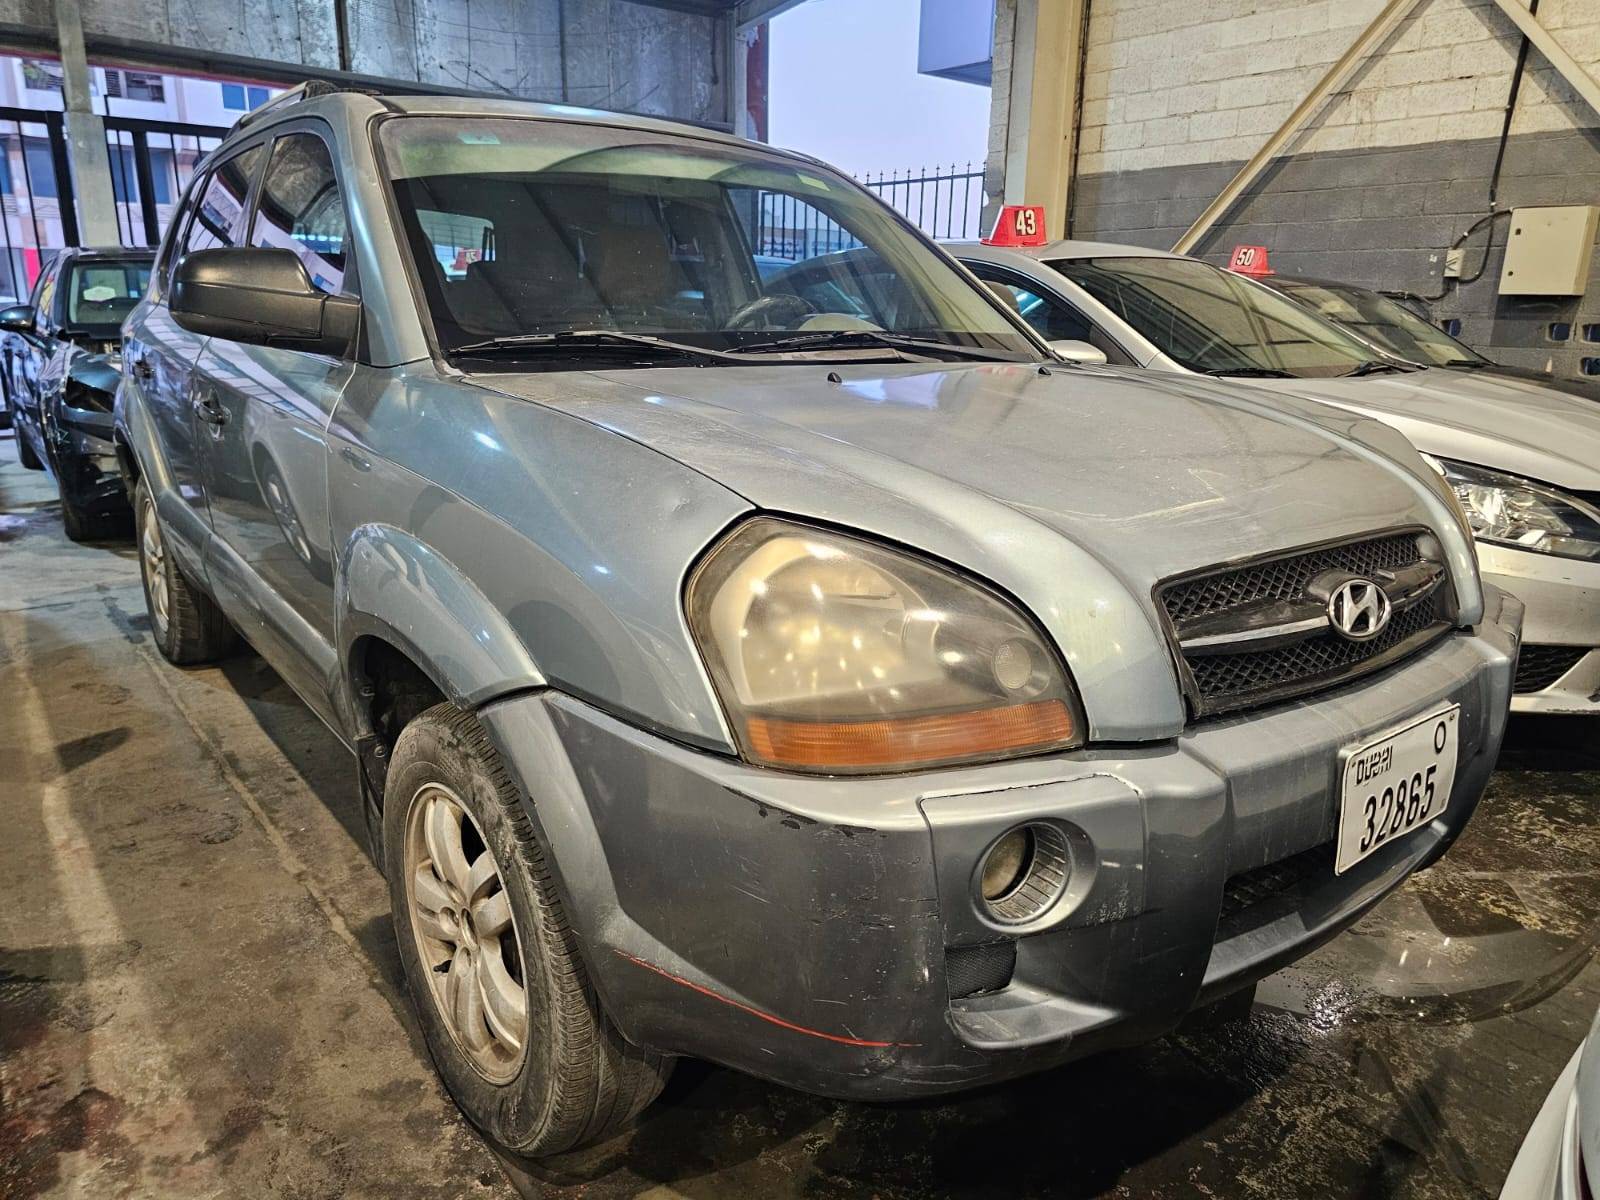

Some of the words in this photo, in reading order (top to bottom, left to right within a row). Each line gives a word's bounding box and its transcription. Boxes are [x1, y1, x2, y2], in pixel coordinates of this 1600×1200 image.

[1016, 209, 1036, 236] 43
[1236, 248, 1255, 266] 50
[1360, 764, 1437, 852] 32865
